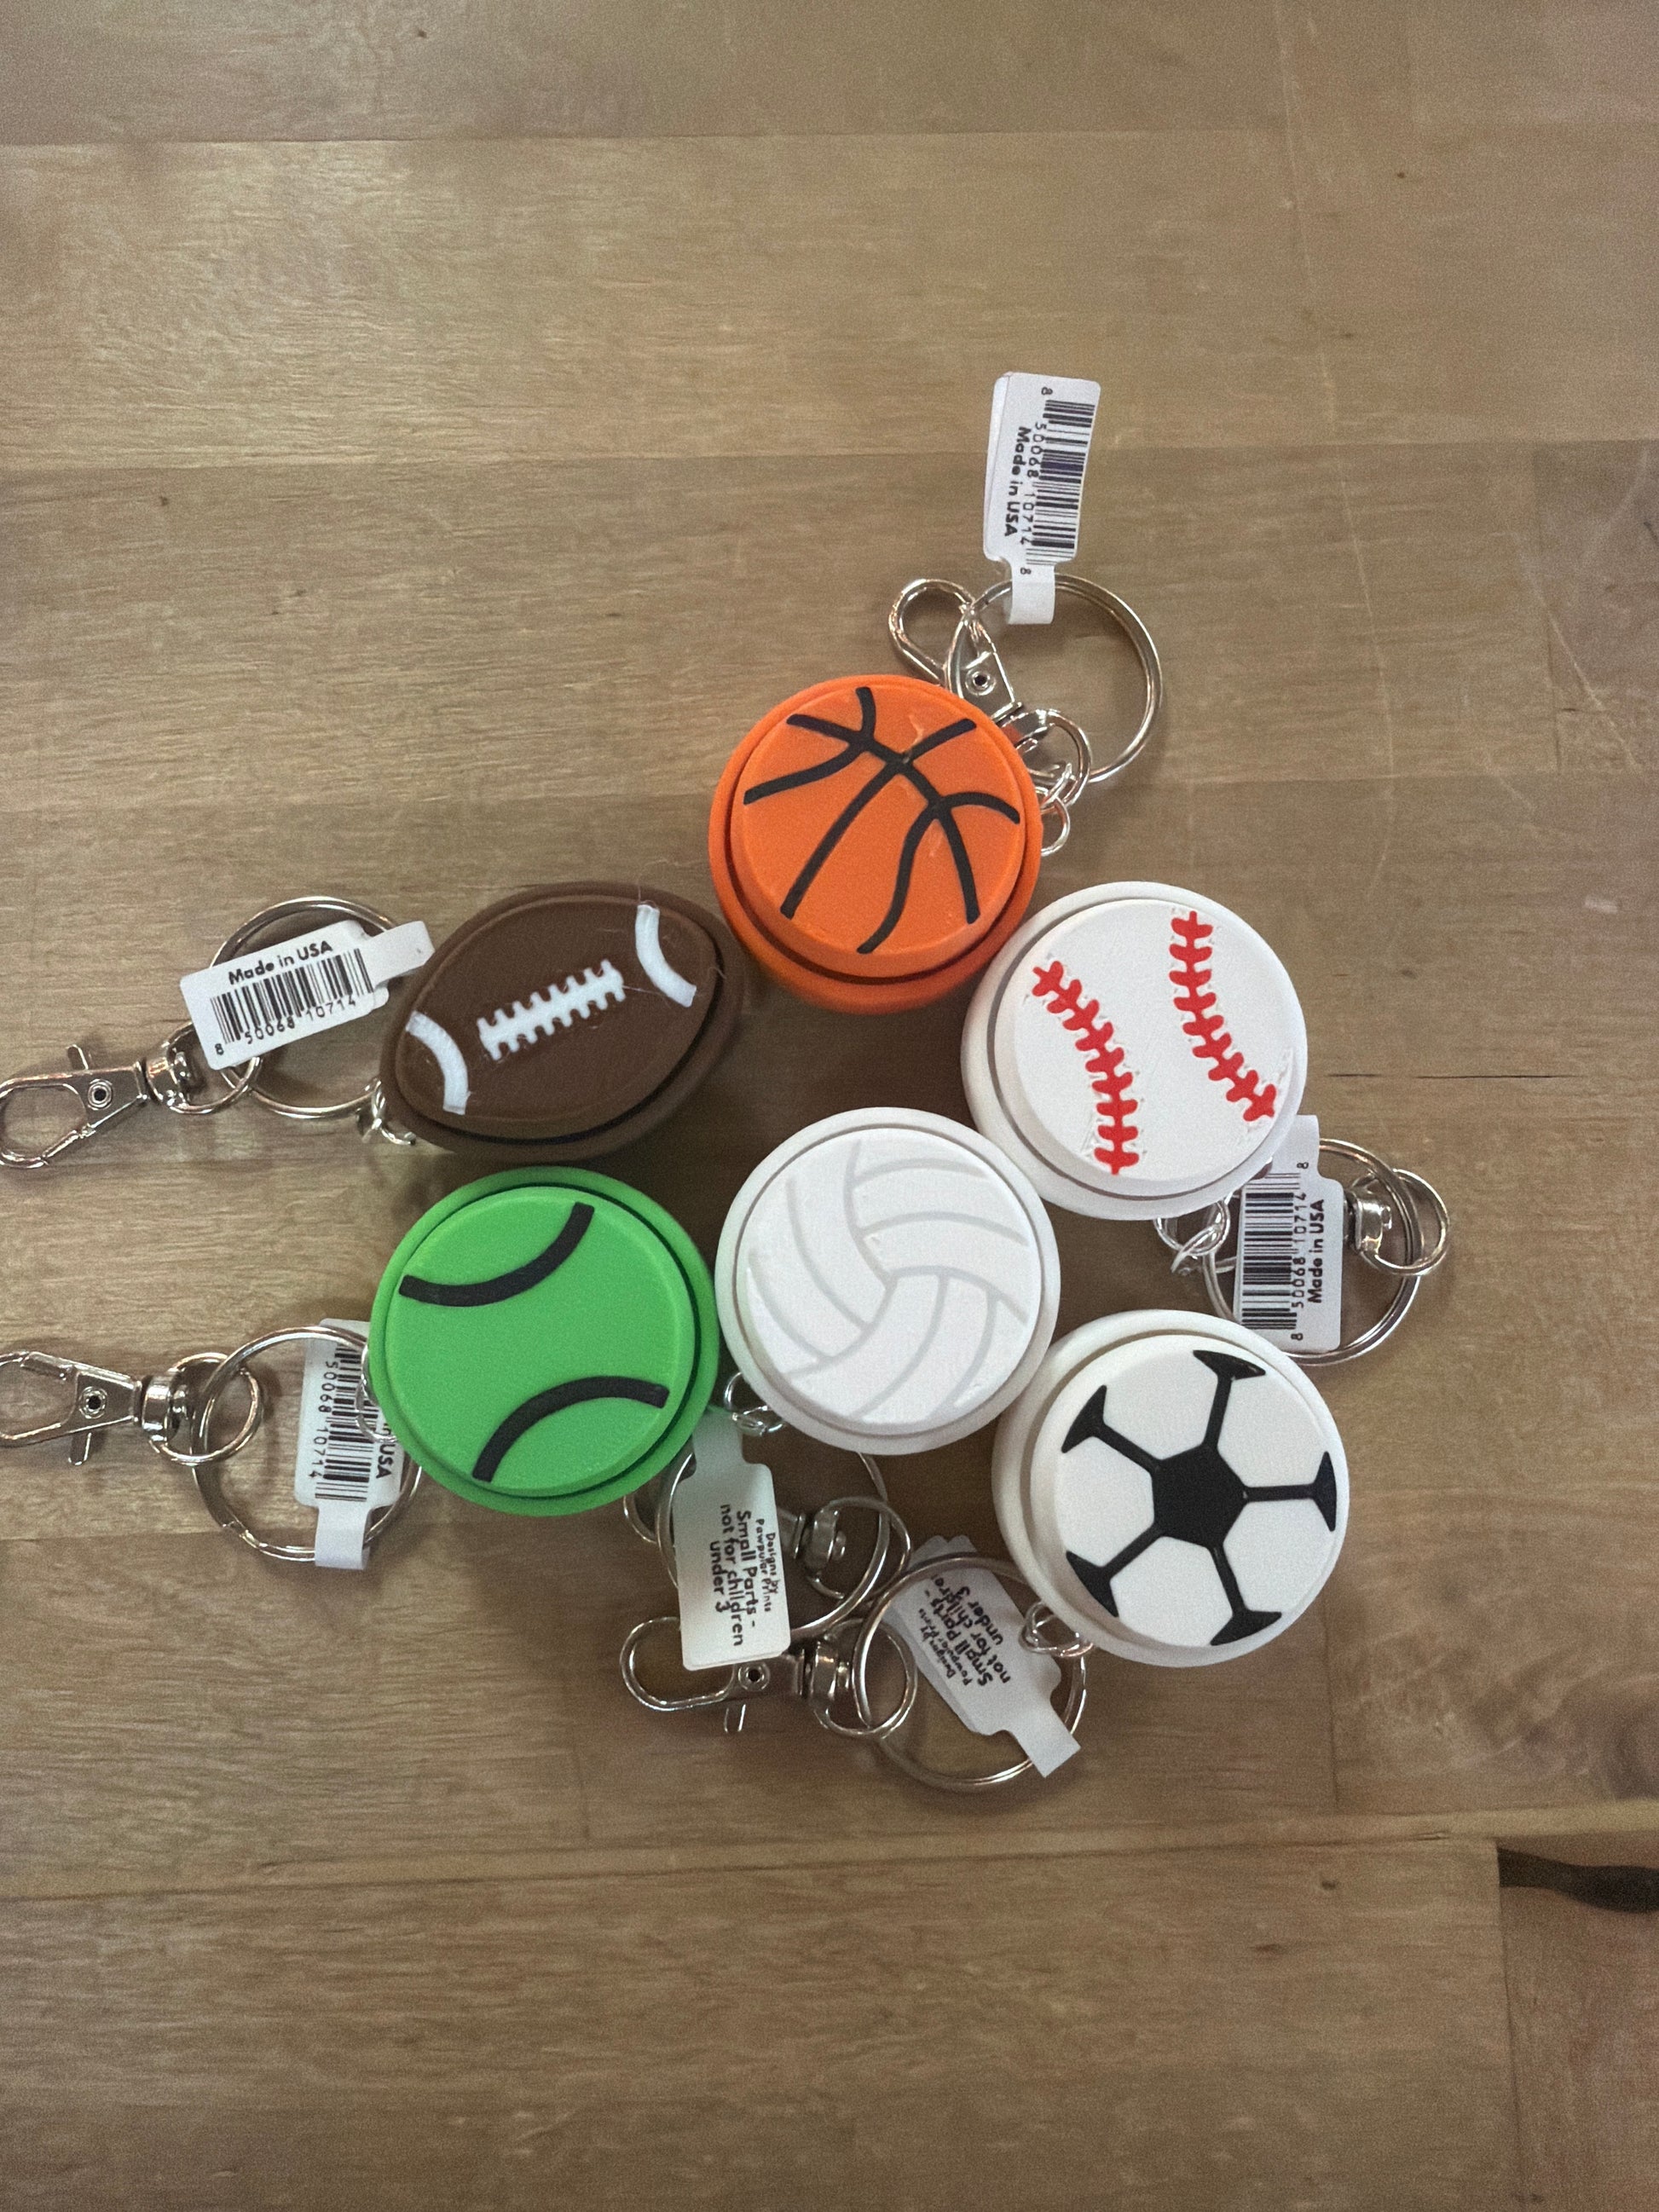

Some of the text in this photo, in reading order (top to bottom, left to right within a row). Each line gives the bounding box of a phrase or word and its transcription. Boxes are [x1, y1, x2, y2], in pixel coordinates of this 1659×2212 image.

[1004, 426, 1032, 536] Made in USA
[1020, 386, 1053, 575] 8 50068 10714 8
[228, 940, 332, 985] Made in USA
[214, 995, 356, 1055] 8 50068 10714
[1296, 1161, 1309, 1170] 8
[1292, 1193, 1307, 1243] 10714
[1308, 1199, 1324, 1303] Made in USA
[1291, 1256, 1306, 1308] 50068
[309, 1361, 338, 1478] 50068 10714
[376, 1442, 396, 1479] USA
[737, 1510, 757, 1561] Small
[710, 1540, 731, 1613] under 3
[720, 1504, 747, 1646] not for children
[743, 1567, 759, 1615] Parts
[930, 1598, 961, 1641] Parts
[931, 1575, 1011, 1684] not for childre
[957, 1586, 1003, 1645] under 3
[955, 1640, 993, 1686] Small
